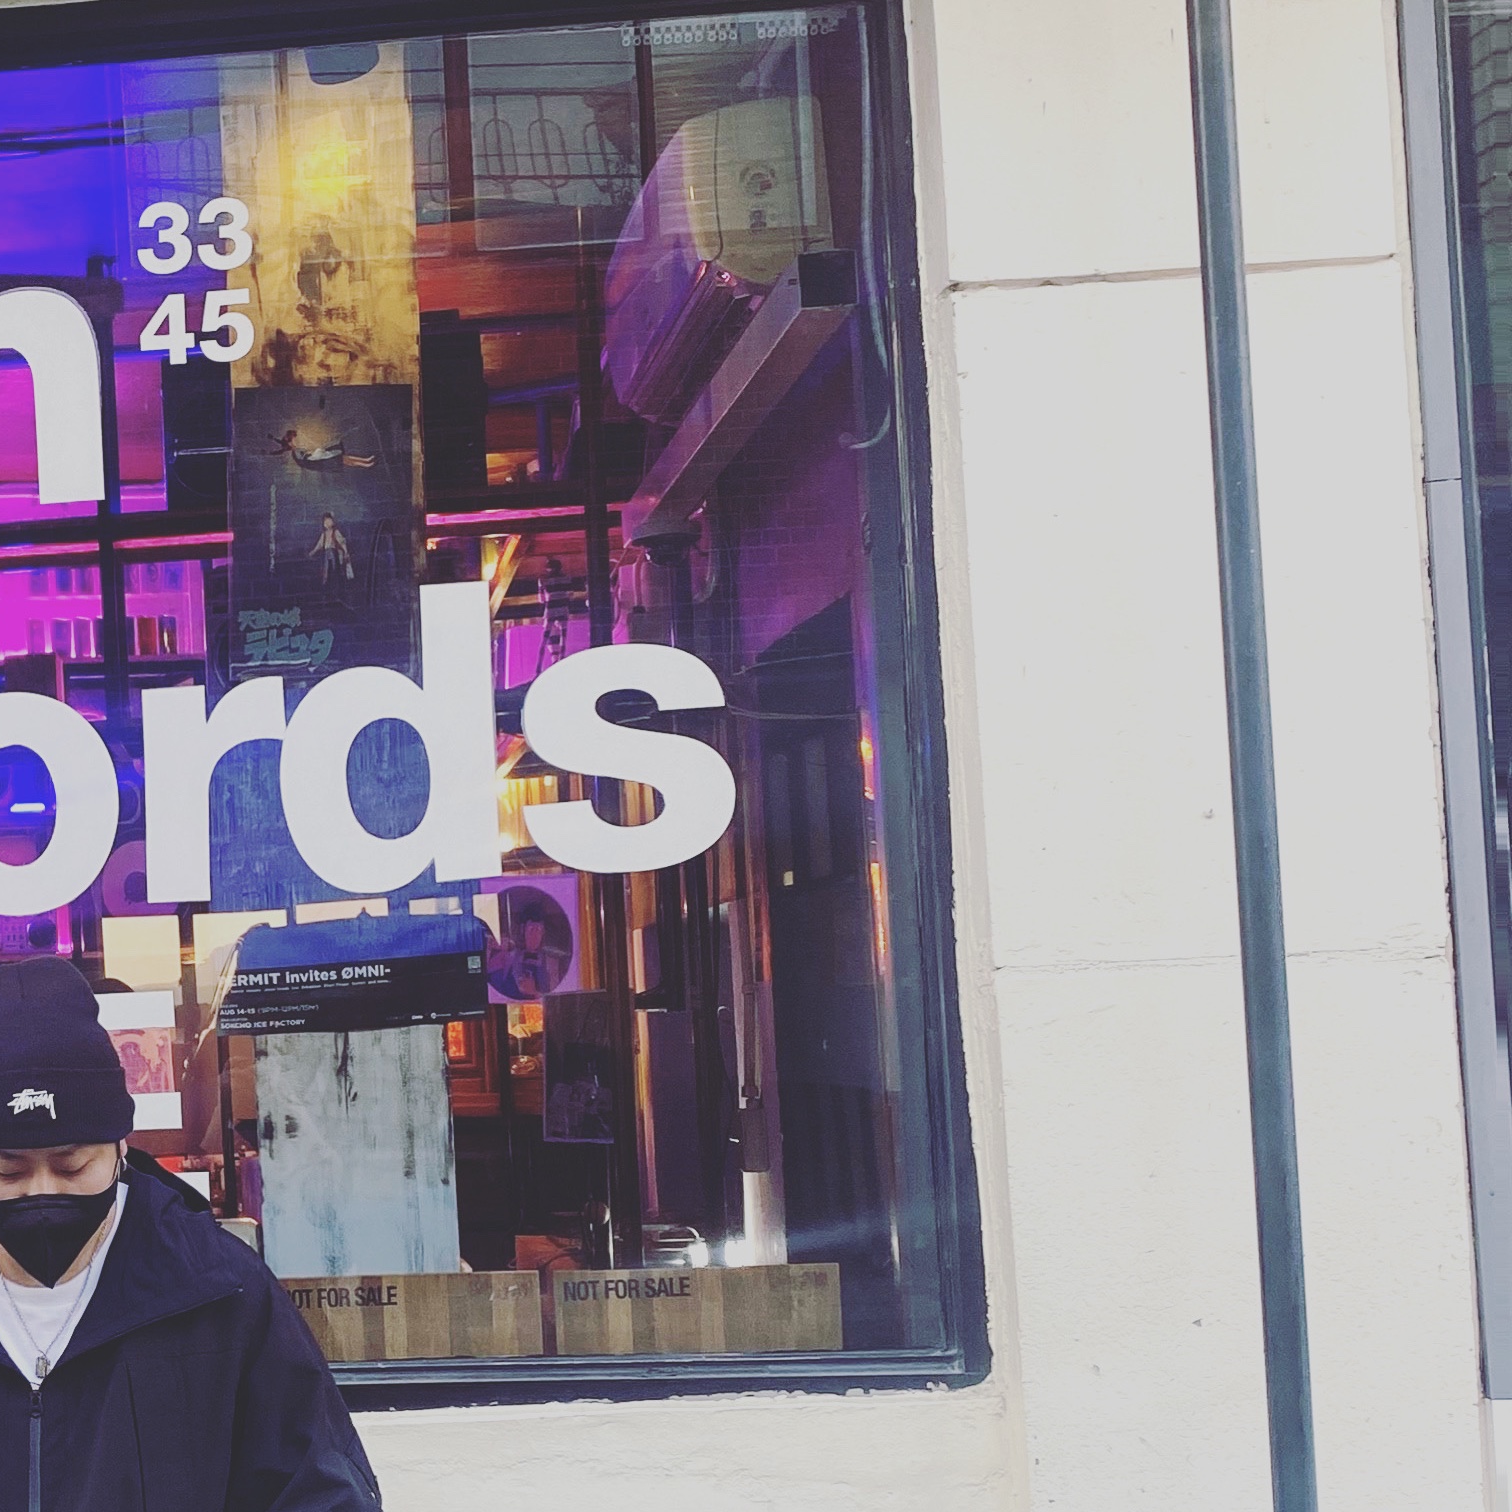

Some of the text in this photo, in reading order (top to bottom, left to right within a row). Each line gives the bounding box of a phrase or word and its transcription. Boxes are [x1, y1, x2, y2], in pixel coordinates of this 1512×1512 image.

[137, 197, 253, 275] 33
[140, 288, 254, 365] 45
[244, 628, 334, 667] ラピュタ
[231, 971, 281, 987] ERMIT
[269, 1018, 306, 1028] FACTORY
[316, 1286, 351, 1309] FOR
[354, 1284, 398, 1307] SALE
[562, 1276, 690, 1302] NOT FOR SALE
